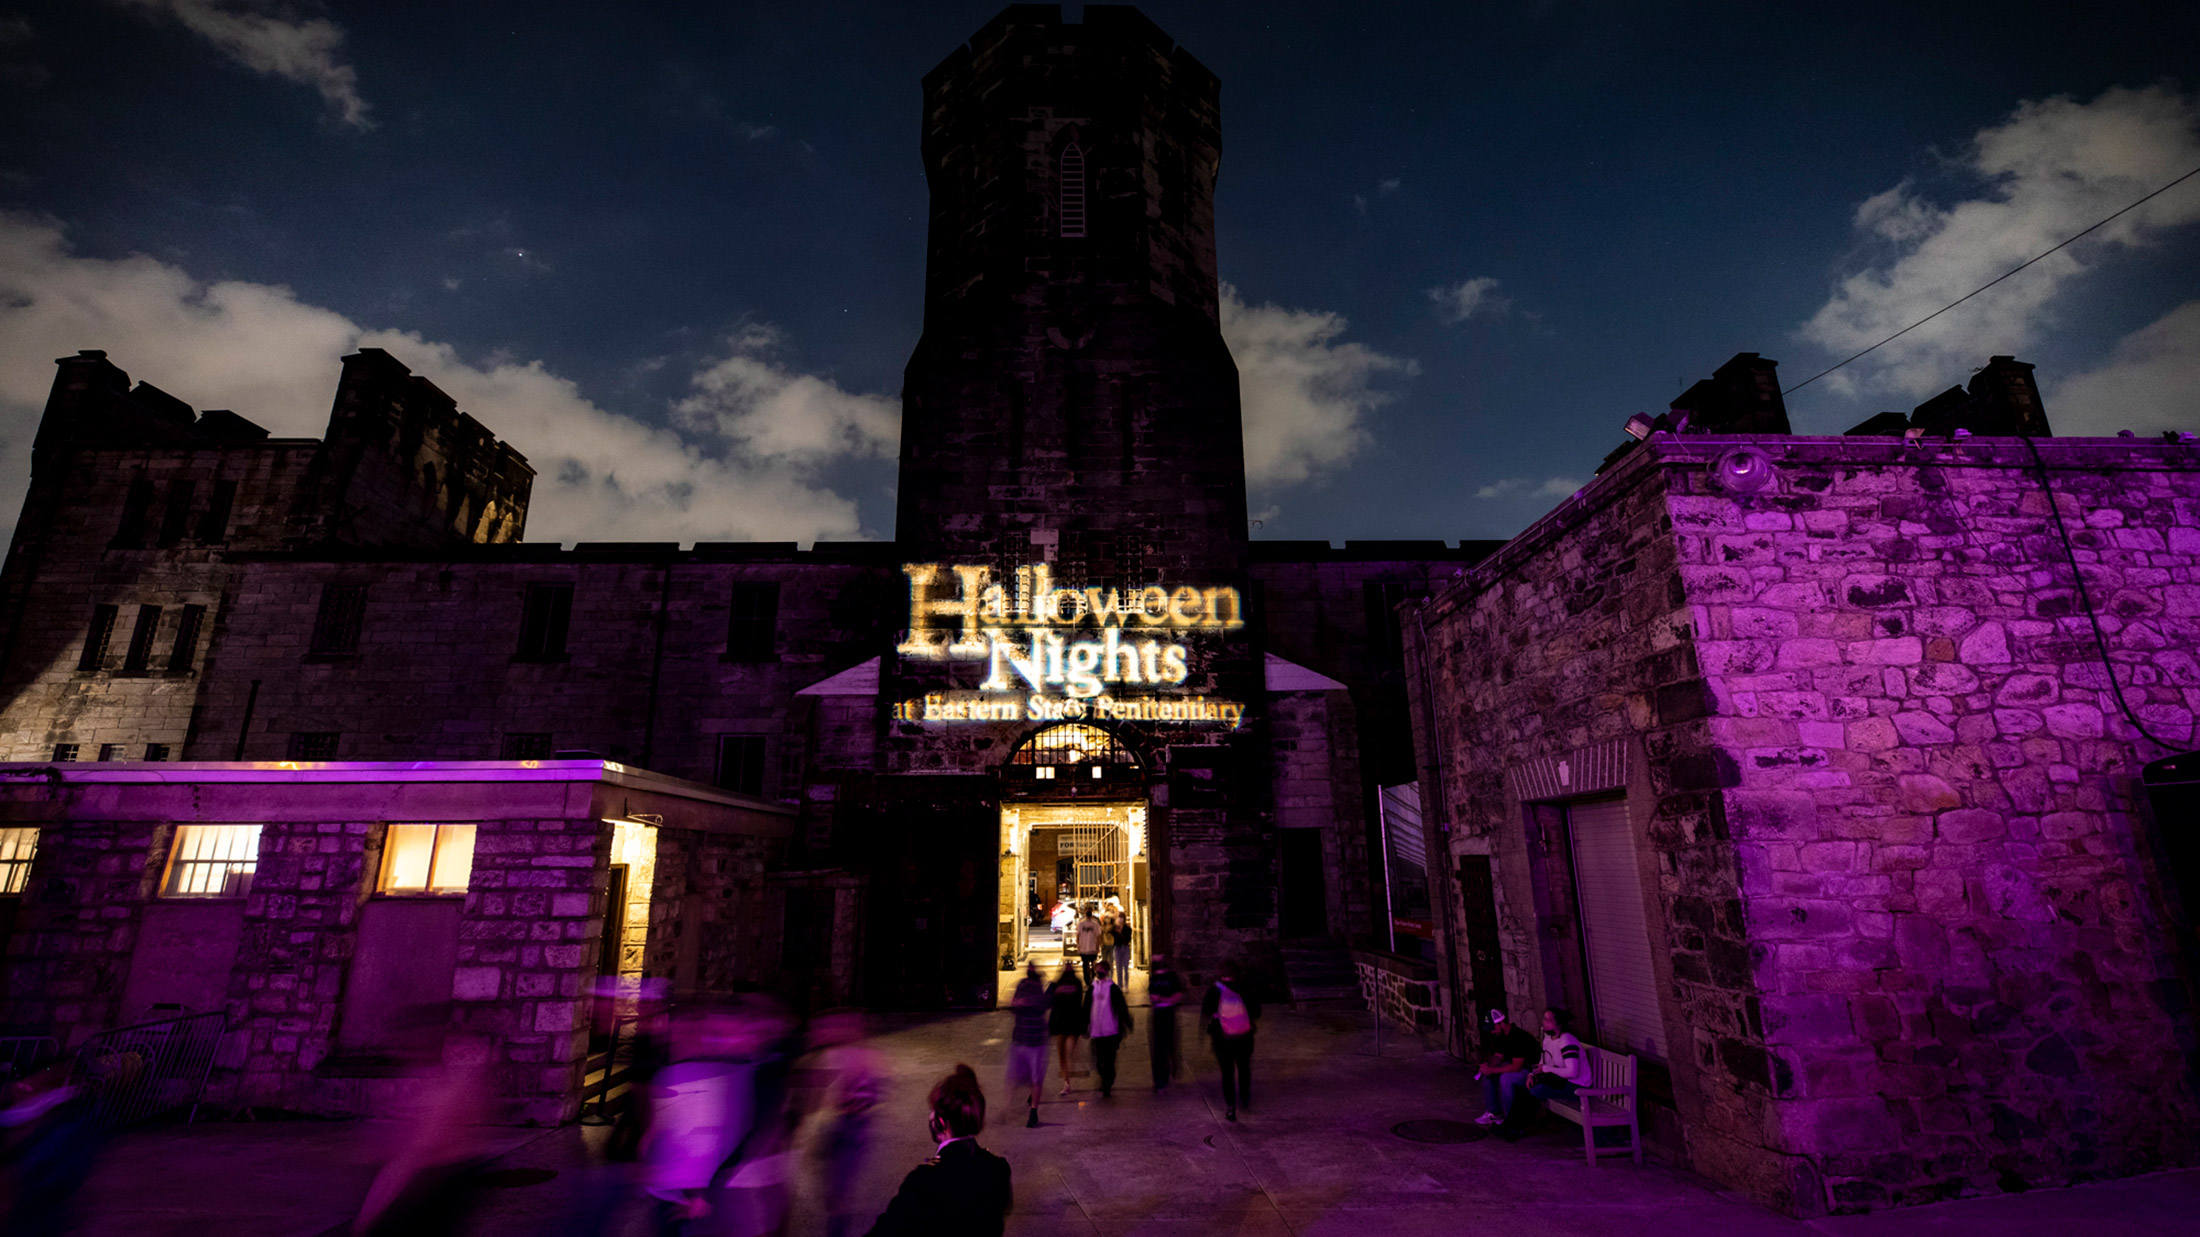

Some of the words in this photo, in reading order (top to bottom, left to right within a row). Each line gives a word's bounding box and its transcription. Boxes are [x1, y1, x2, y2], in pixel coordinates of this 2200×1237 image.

[897, 563, 1245, 655] Halloween
[980, 627, 1188, 698] Nights
[892, 700, 913, 720] at
[924, 695, 1019, 720] Eastern
[1028, 694, 1087, 720] Sta
[1097, 695, 1245, 729] Penitentiary
